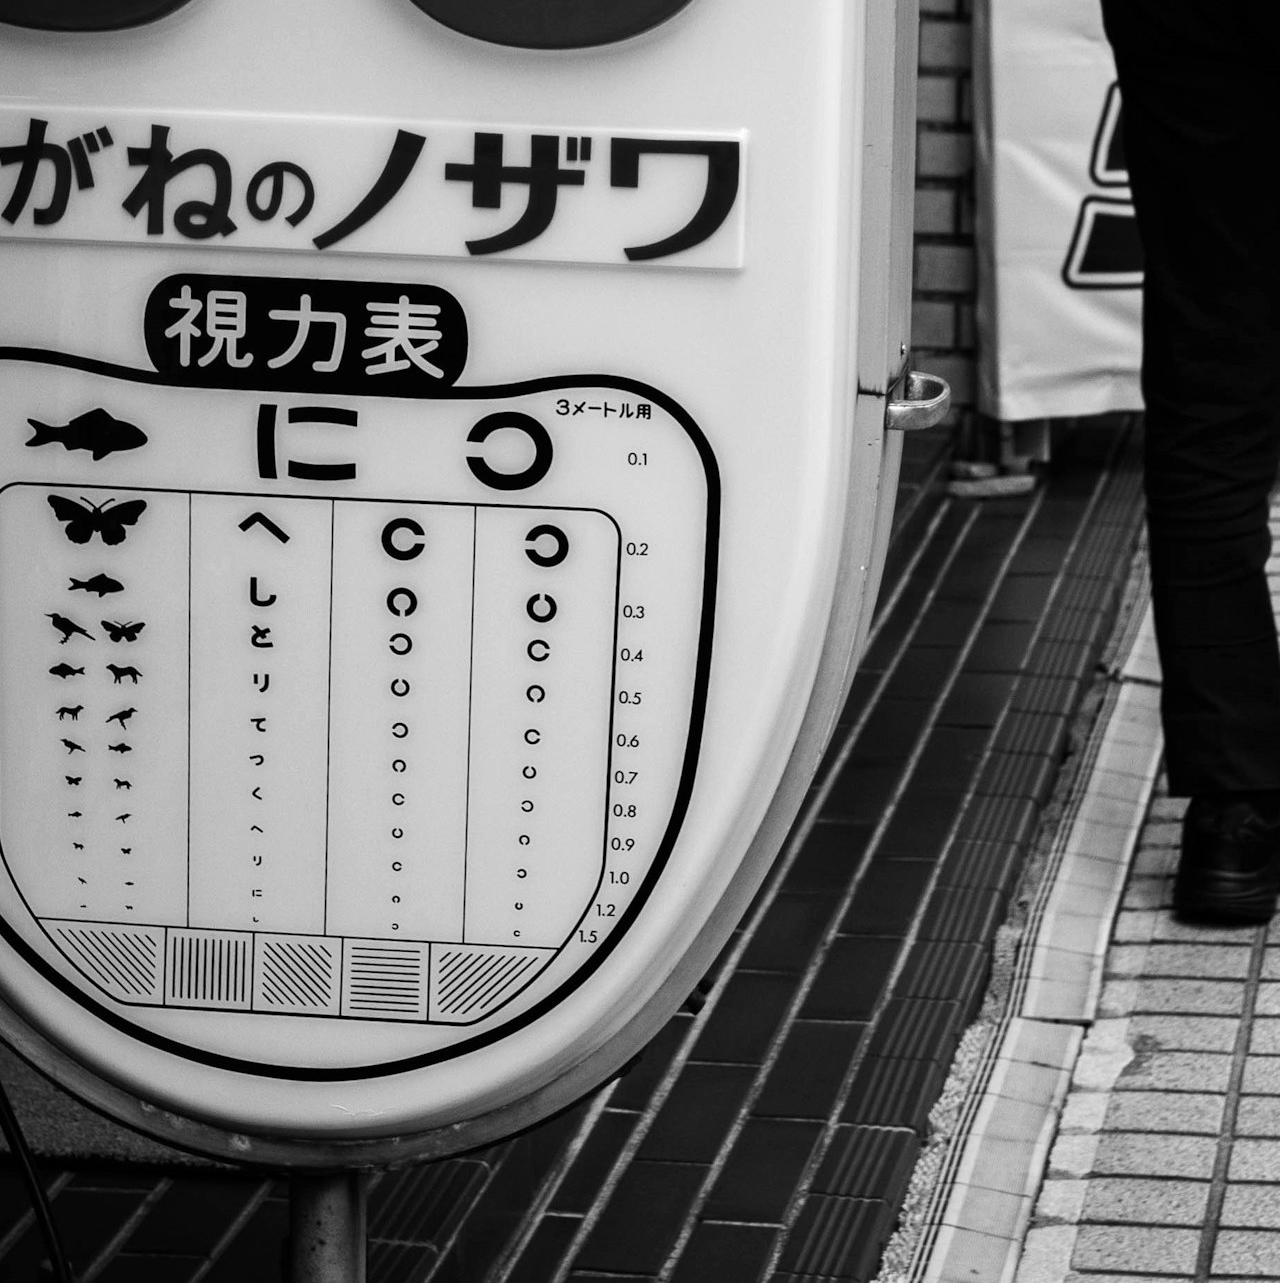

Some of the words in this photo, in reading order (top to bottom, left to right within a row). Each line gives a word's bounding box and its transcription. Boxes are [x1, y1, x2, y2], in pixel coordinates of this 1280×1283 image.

[165, 284, 446, 380] 視力表
[555, 398, 652, 420] 3メートル用
[257, 404, 358, 481] に
[627, 452, 648, 466] 0.1
[239, 512, 290, 543] へ
[626, 542, 649, 556] 0.2
[249, 576, 277, 608] し
[622, 604, 645, 619] 0.3
[250, 624, 274, 649] と
[620, 647, 644, 662] 0.4
[618, 690, 642, 705] 0.5
[250, 717, 267, 733] て
[616, 733, 640, 748] 0.6
[249, 754, 265, 766] つ
[614, 770, 639, 785] 0.7
[251, 786, 263, 801] く
[612, 803, 637, 818] 0.8
[610, 837, 635, 852] 0.9
[609, 870, 630, 885] 1.0
[596, 903, 617, 918] 1.2
[578, 929, 599, 944] 1.5
